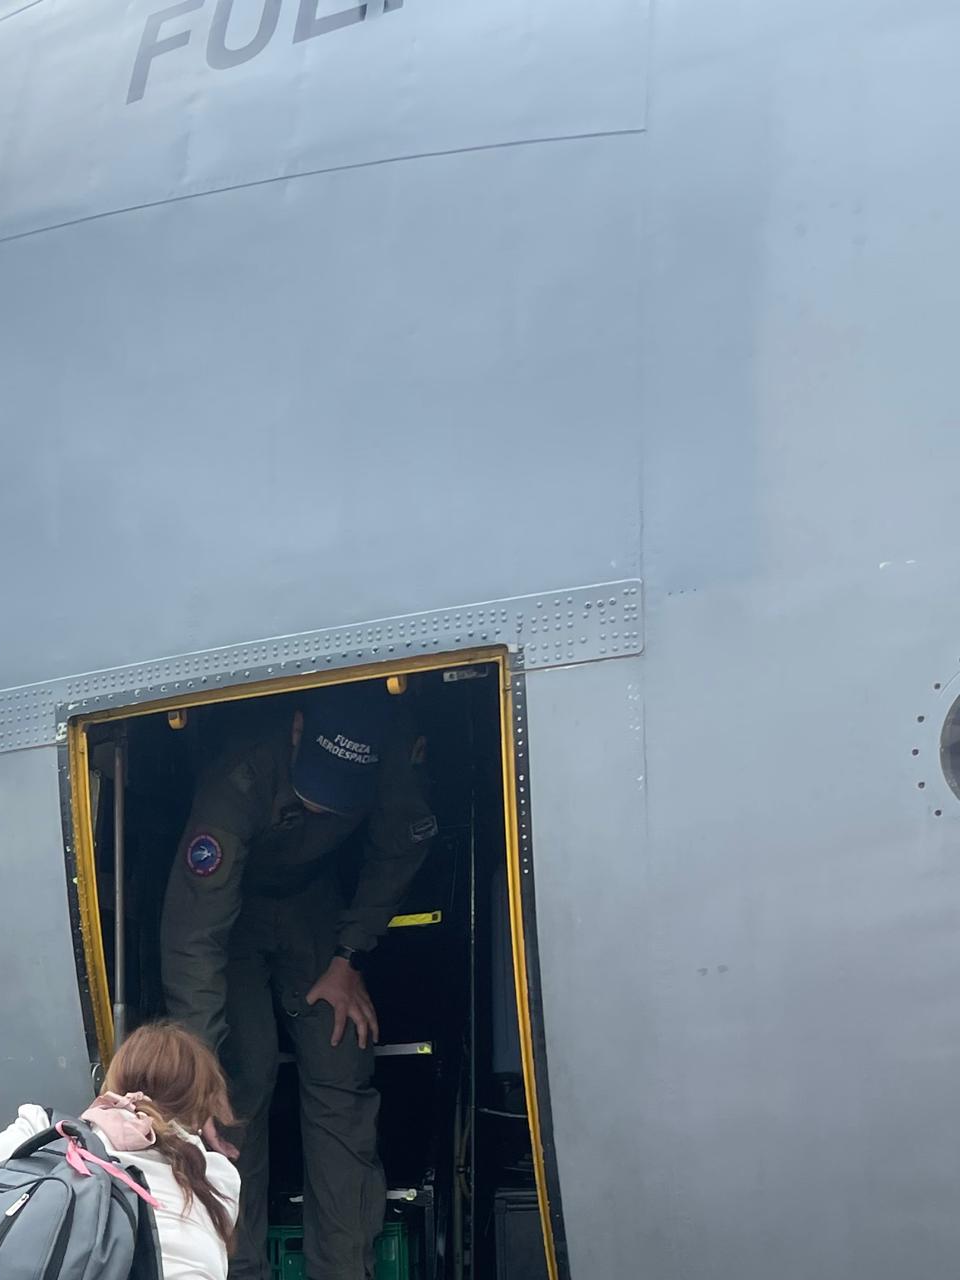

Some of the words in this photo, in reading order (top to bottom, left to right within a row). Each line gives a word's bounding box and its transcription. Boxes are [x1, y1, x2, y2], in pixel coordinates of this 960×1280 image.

[126, 0, 404, 105] FU
[316, 735, 379, 764] AEROESPAC
[334, 734, 371, 754] FUERZA
